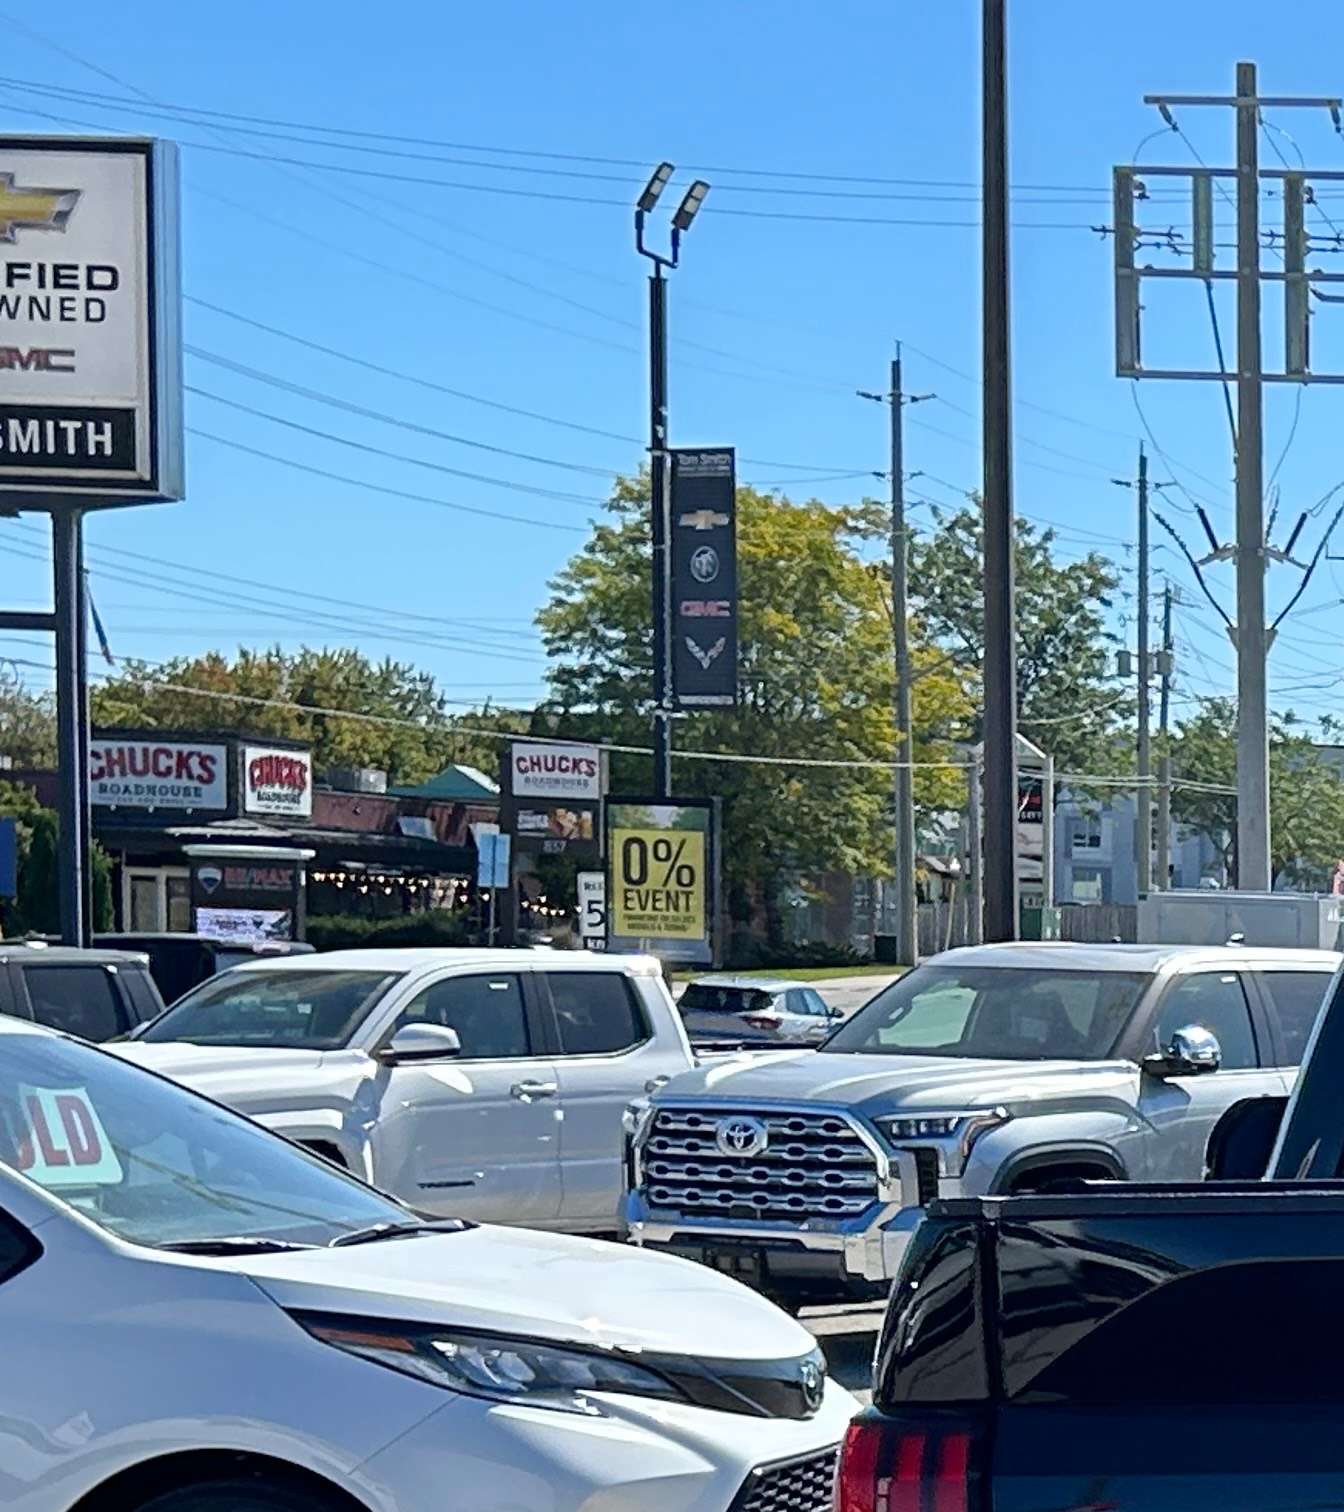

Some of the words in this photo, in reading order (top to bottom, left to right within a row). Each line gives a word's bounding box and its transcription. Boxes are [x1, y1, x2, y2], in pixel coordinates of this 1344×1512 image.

[0, 347, 75, 372] MC
[0, 418, 112, 456] MITH
[680, 601, 731, 617] GMC
[98, 782, 203, 798] ROADHOUSE
[622, 836, 696, 888] 0%
[623, 888, 695, 913] EVENT
